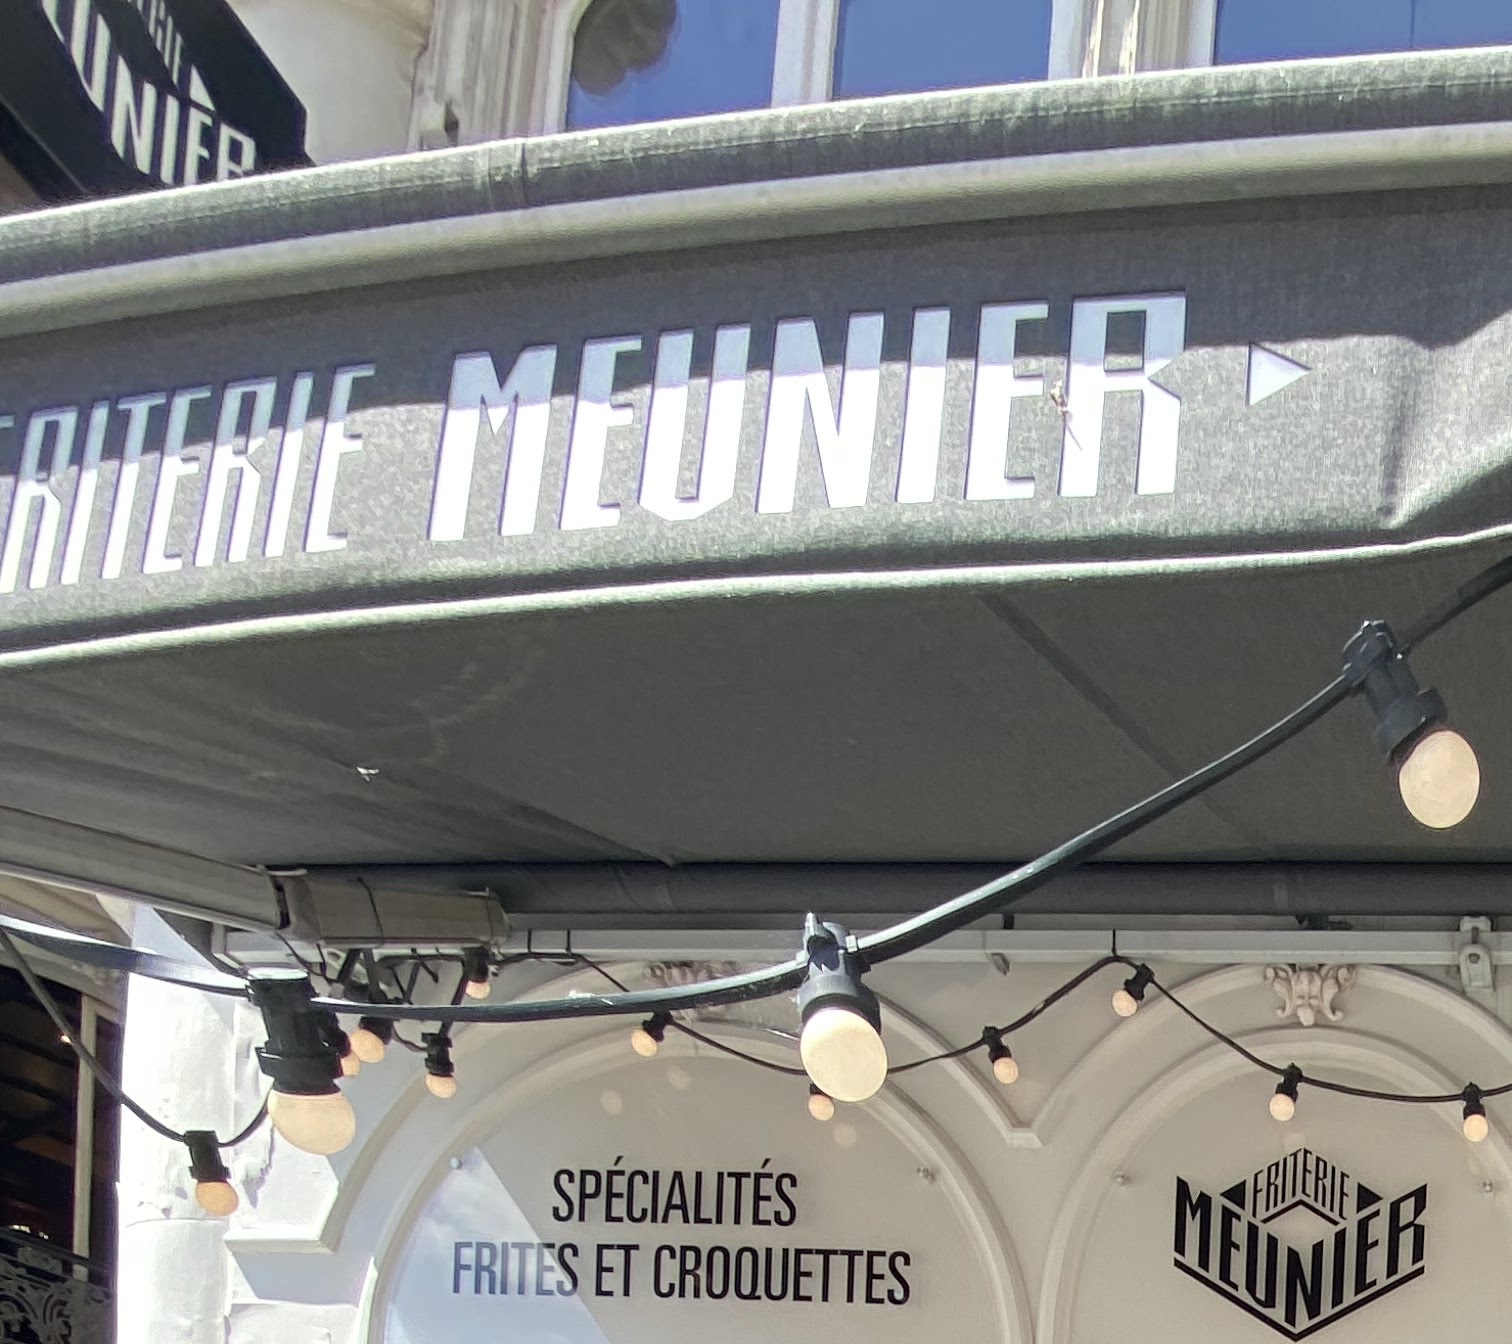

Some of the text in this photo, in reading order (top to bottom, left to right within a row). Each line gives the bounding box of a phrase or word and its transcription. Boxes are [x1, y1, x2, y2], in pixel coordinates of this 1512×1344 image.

[0, 291, 1187, 593] RITERIE MEUNIER
[552, 1155, 798, 1226] SPÉCIALITÉS
[1252, 1147, 1350, 1221] FRITERIE
[452, 1240, 911, 1306] FRITES ET CROQUETTES
[1174, 1175, 1428, 1328] MEUNIER
